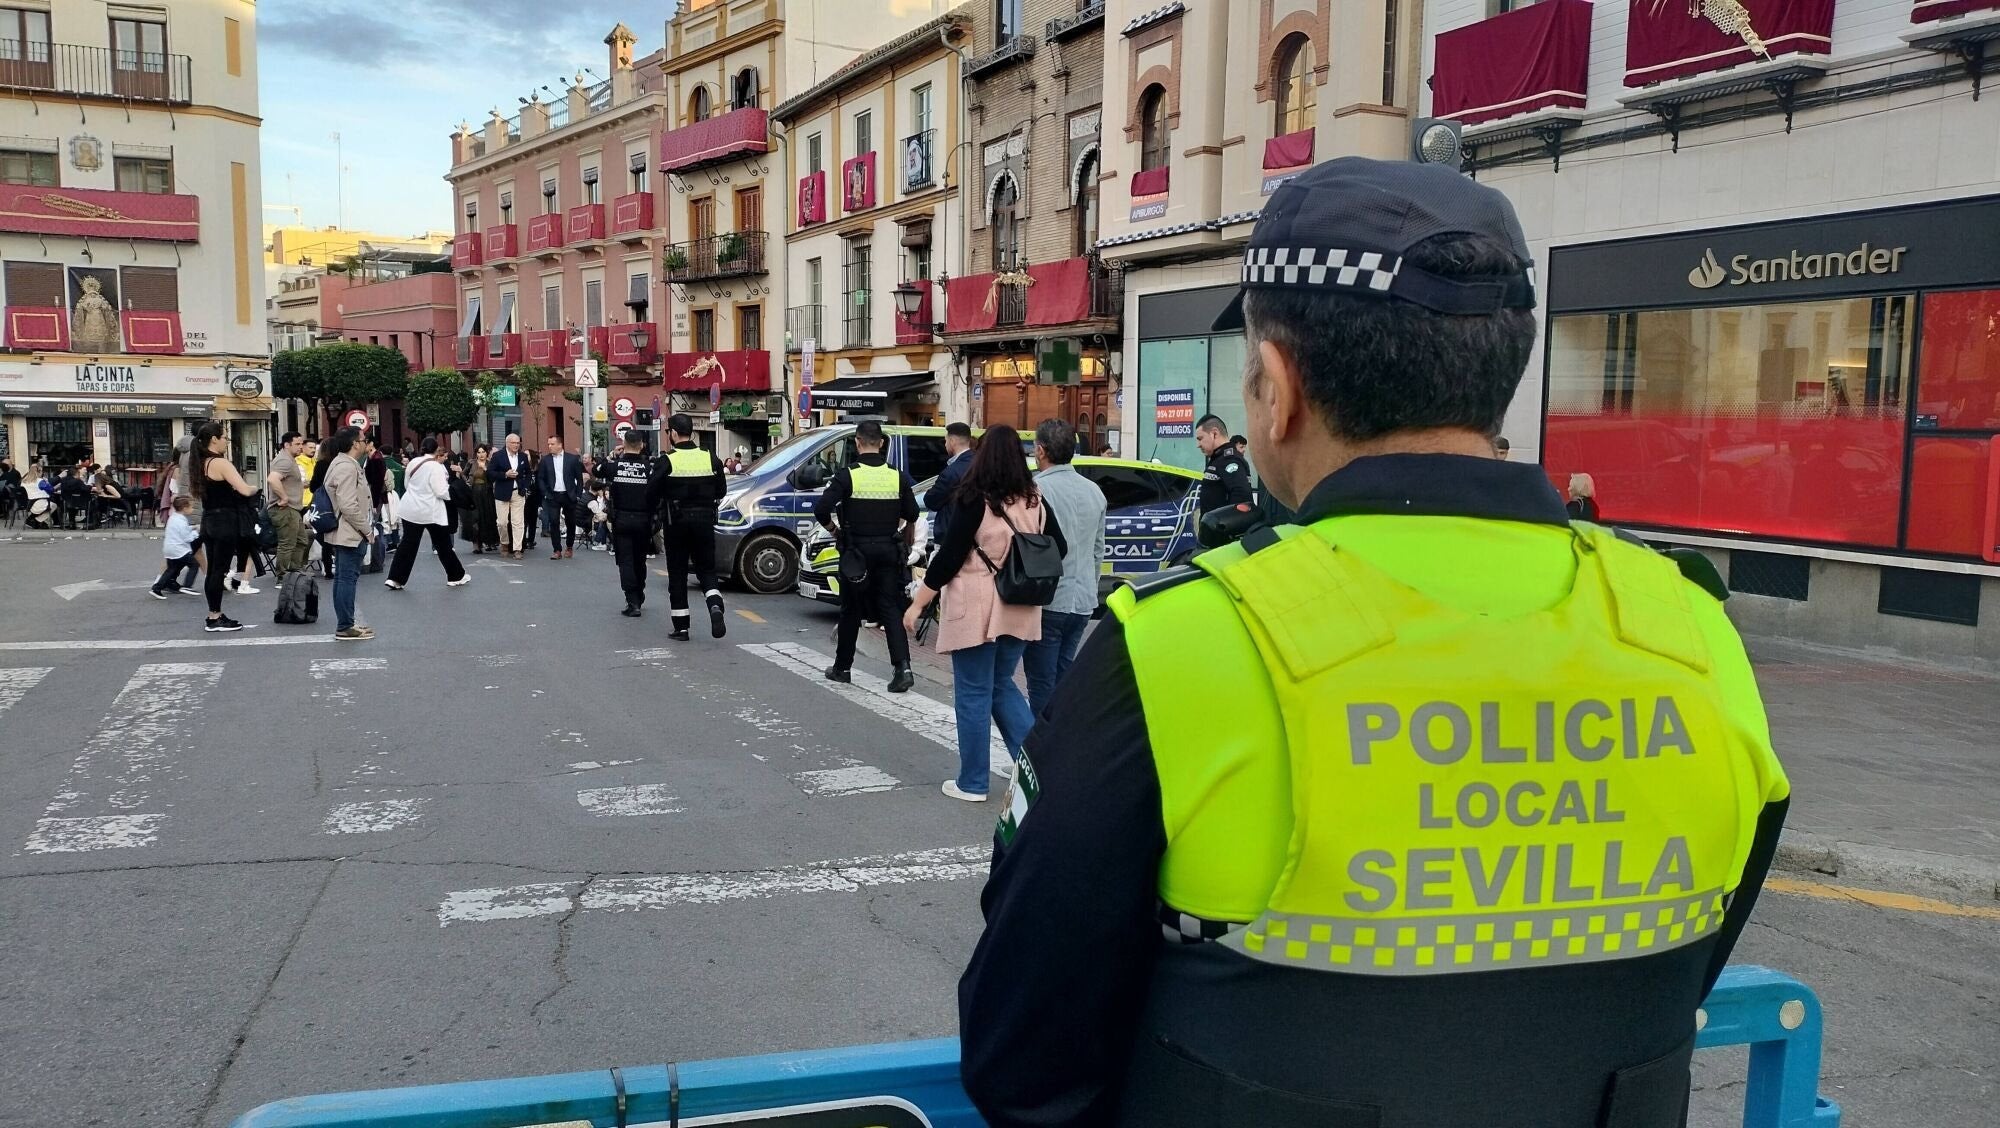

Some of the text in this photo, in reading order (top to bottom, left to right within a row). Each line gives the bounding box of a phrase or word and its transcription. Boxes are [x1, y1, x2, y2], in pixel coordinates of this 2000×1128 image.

[1730, 242, 1907, 285] Santander
[76, 366, 134, 382] LA CINTA
[1000, 363, 1029, 375] FARCIA
[76, 382, 135, 392] TAPAS & COPAS
[1158, 393, 1191, 401] DISPONIBLE
[58, 403, 93, 413] CAFETERÍA
[100, 405, 109, 413] LA
[110, 405, 130, 414] CINTA
[135, 405, 156, 414] TAPAS
[1168, 410, 1176, 418] 27
[1158, 425, 1192, 434] APIBURGOS
[617, 461, 646, 469] POLICIA
[616, 469, 647, 478] SEVILLA
[1346, 696, 1696, 765] POLICIA
[1018, 753, 1035, 790] LOCAL
[1419, 779, 1626, 830] LOCAL
[1343, 836, 1695, 913] SEVILLA
